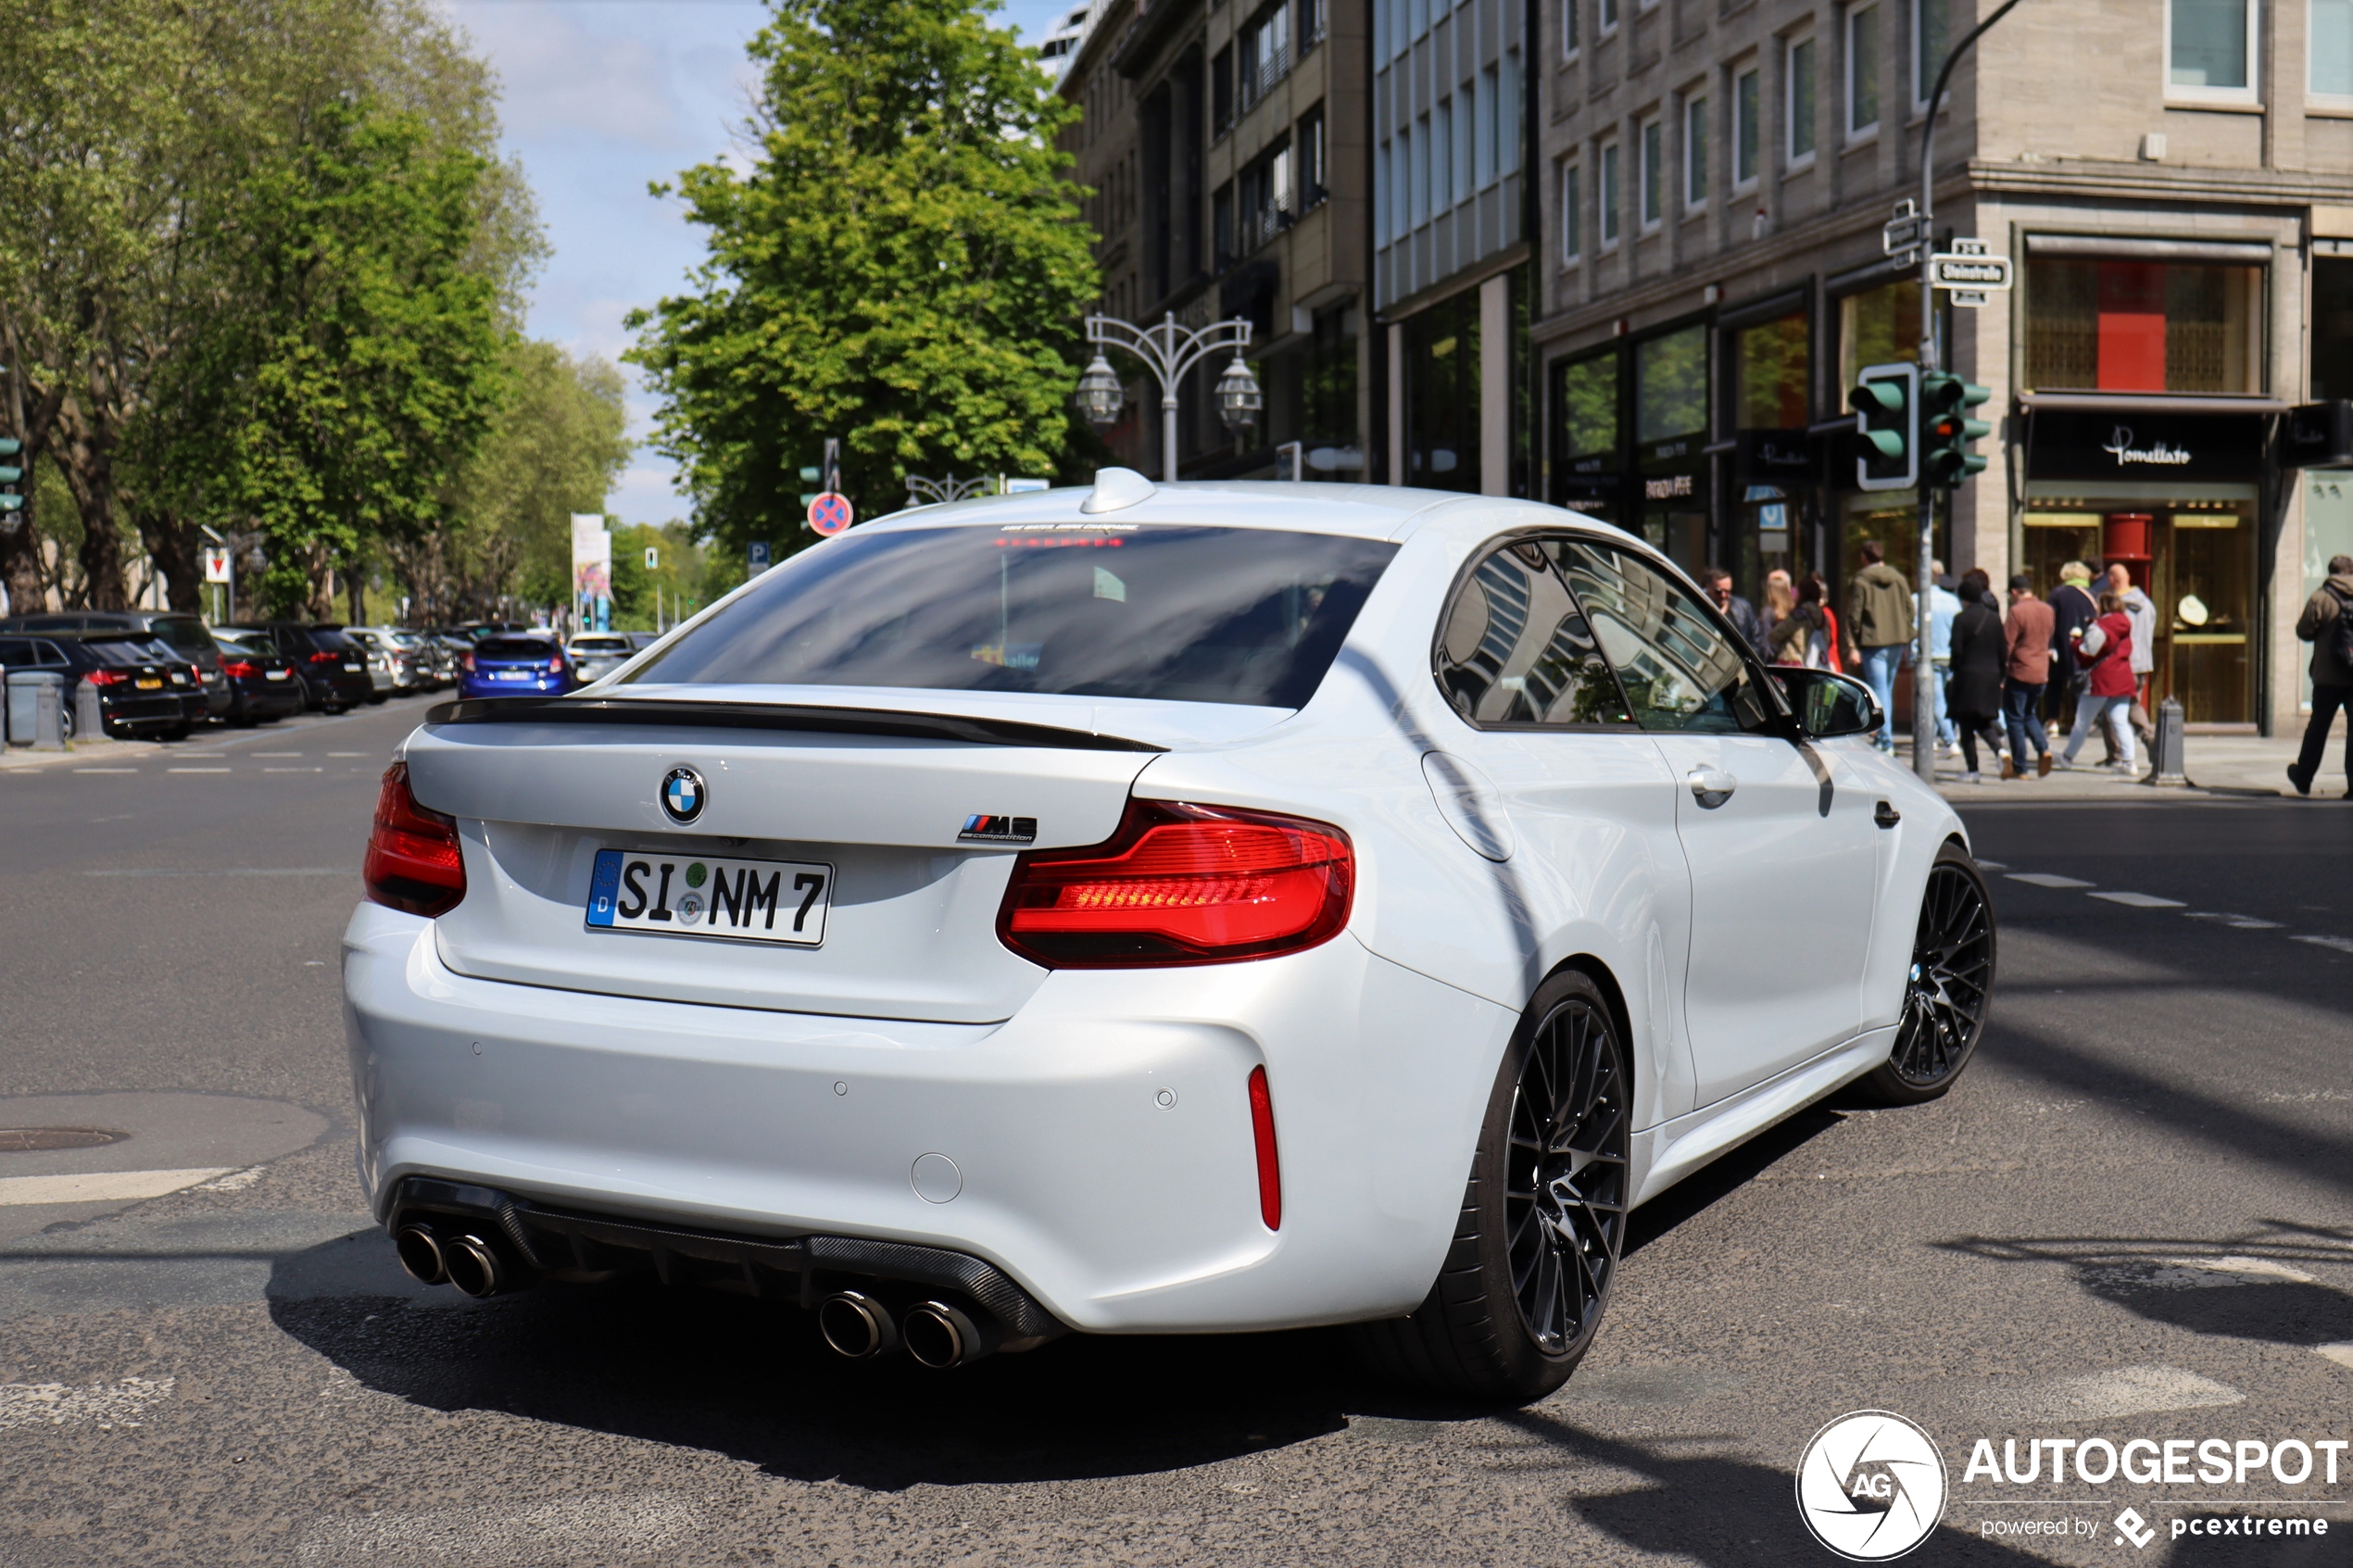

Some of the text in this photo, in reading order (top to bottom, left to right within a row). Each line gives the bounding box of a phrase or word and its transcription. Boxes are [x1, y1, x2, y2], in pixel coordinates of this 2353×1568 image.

[1942, 264, 2002, 281] Steinstraße
[2101, 424, 2192, 466] Pomellato
[752, 545, 766, 563] P
[983, 815, 1038, 834] M2
[973, 833, 1033, 841] competition
[597, 897, 609, 913] D
[618, 861, 674, 920] SI
[708, 867, 781, 929] NM
[793, 872, 825, 931] 7
